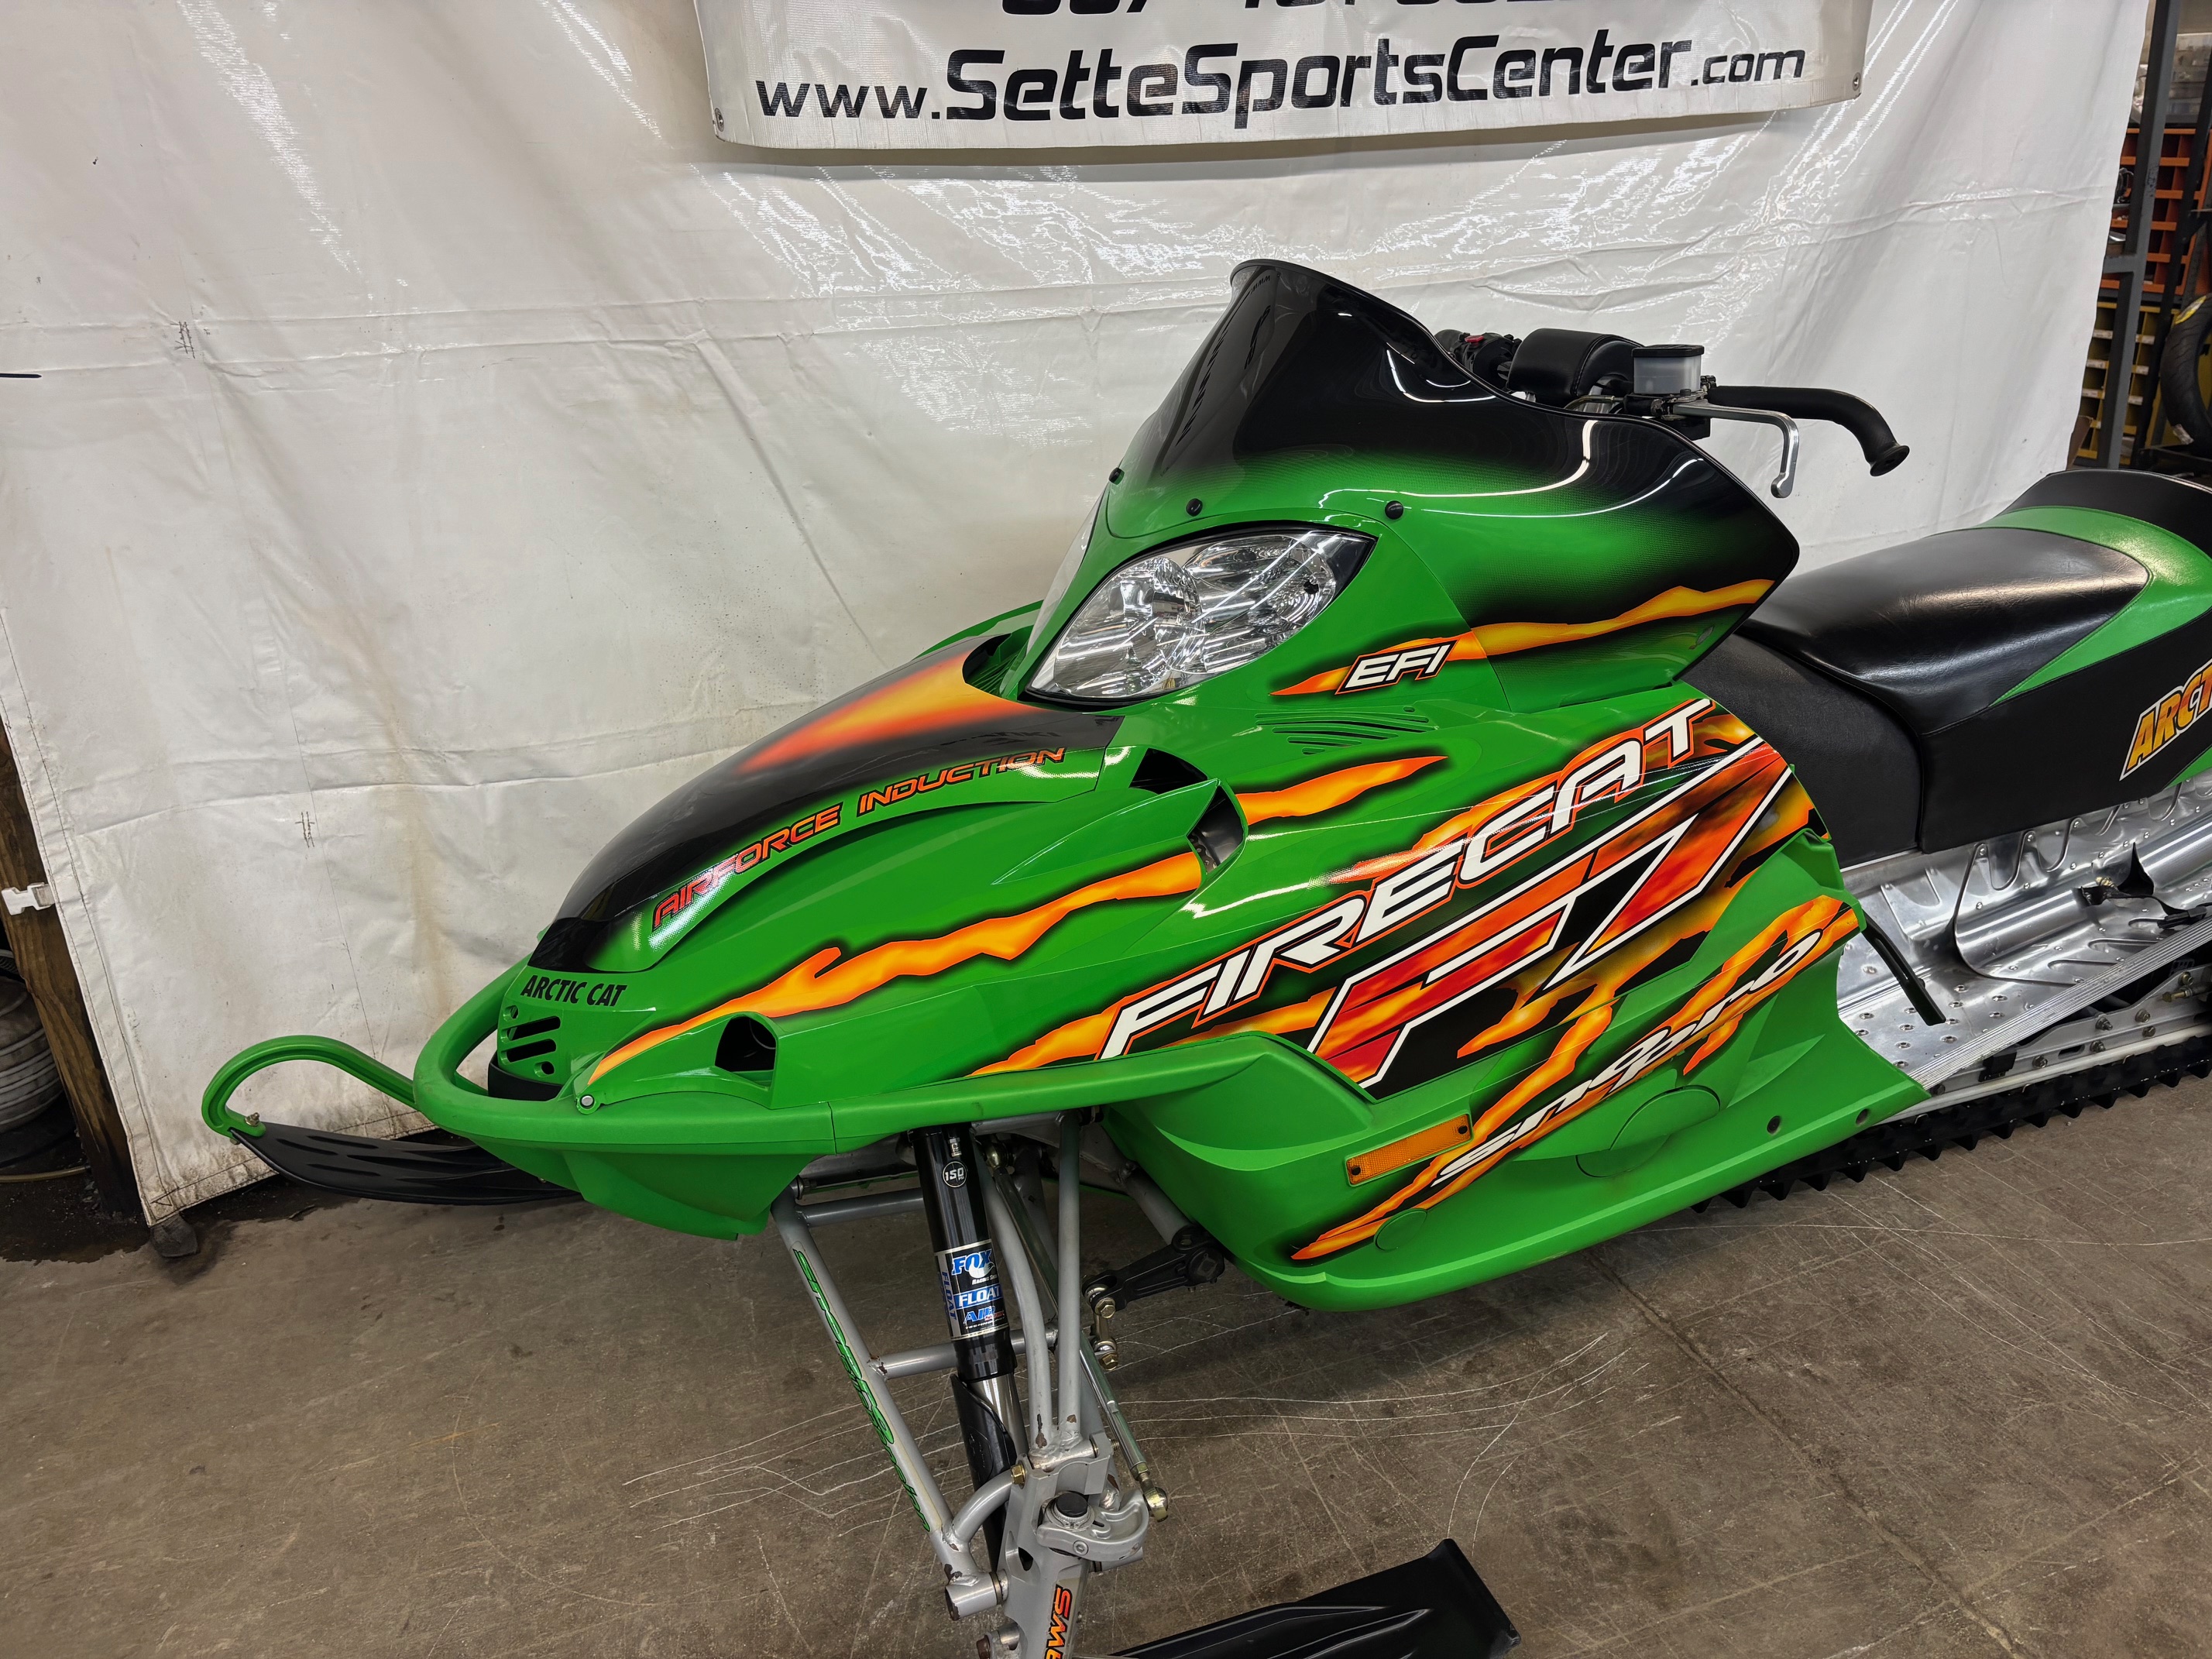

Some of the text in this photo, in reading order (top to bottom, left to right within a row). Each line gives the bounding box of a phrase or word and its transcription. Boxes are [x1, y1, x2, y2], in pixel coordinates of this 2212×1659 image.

[755, 29, 1806, 129] www.SetteSportsCenter.com
[1344, 644, 1453, 691] EFI
[653, 747, 1066, 929] AIRFORCE INDUCTION
[1098, 698, 1712, 1060] FIRECAT
[520, 974, 628, 1007] ARCTIC CAT
[945, 1166, 964, 1182] 150
[951, 1249, 992, 1276] FOX
[942, 1271, 957, 1321] FLOAT
[959, 1286, 1001, 1307] FLOAT
[963, 1305, 996, 1324] AIR
